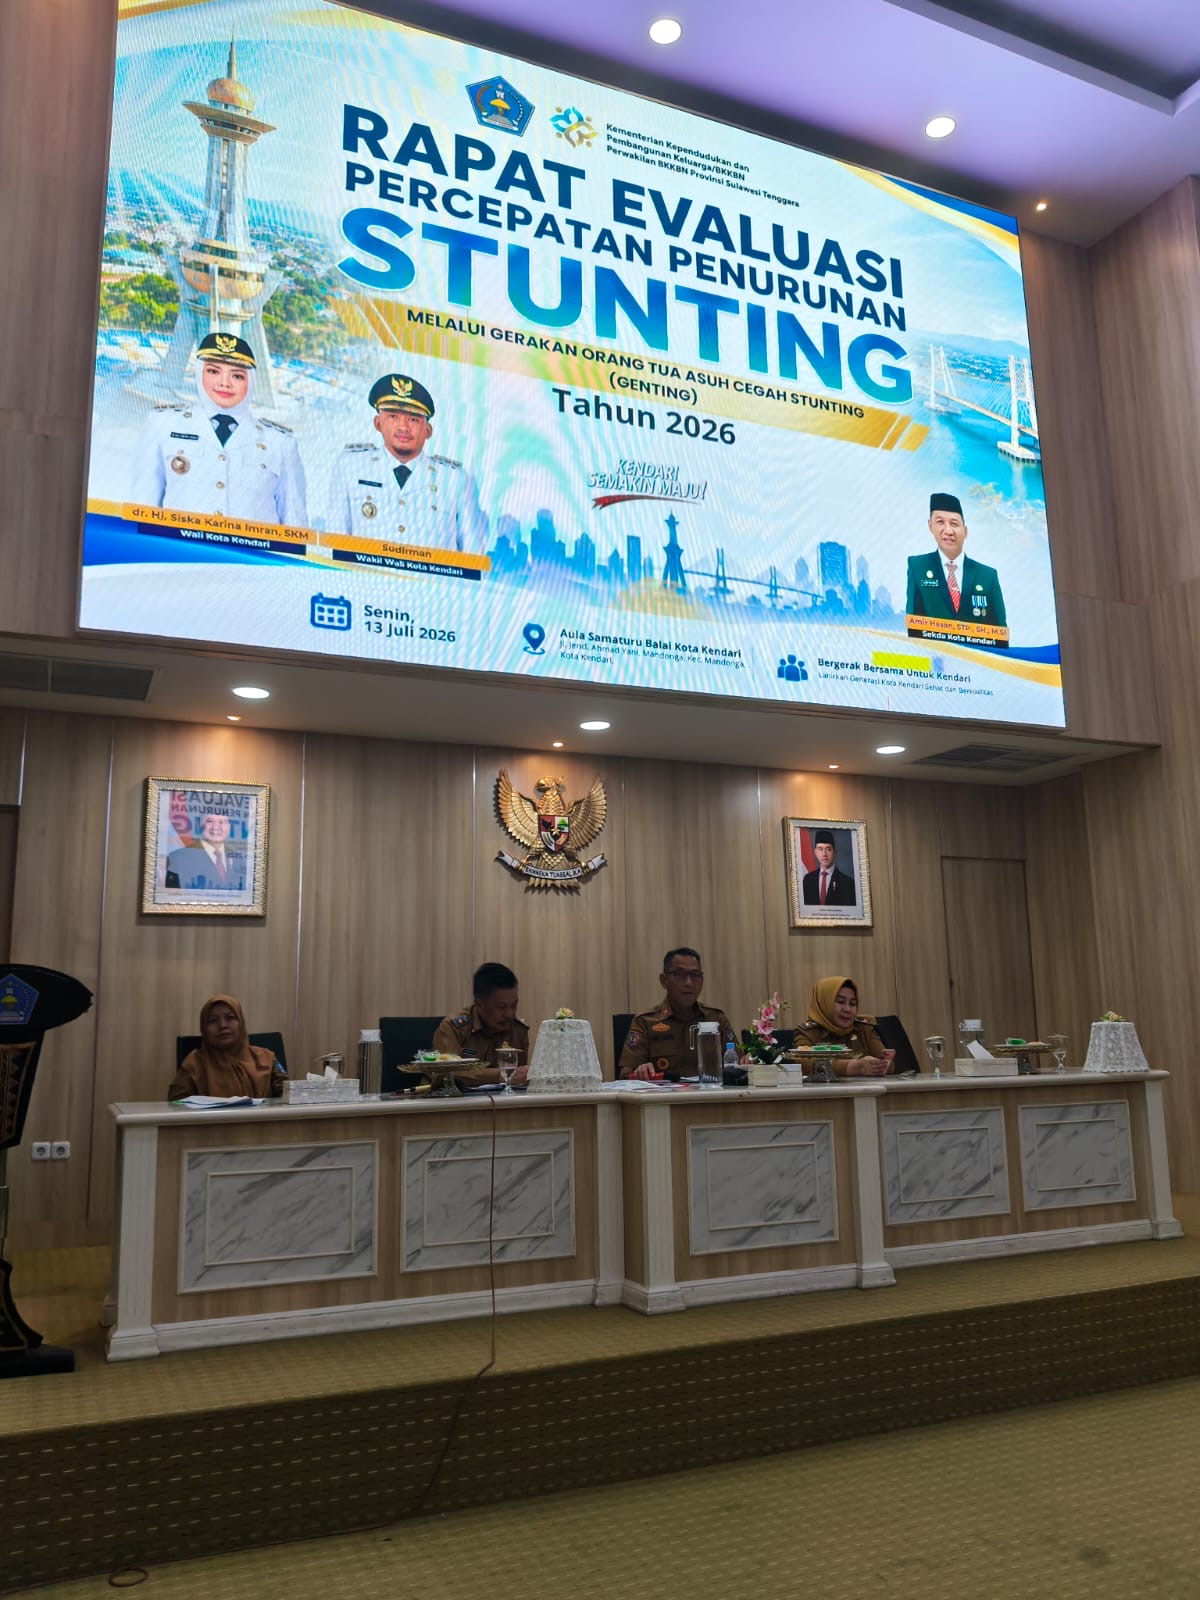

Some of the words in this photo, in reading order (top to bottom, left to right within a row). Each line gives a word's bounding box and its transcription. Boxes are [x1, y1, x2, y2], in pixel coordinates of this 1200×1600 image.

[606, 123, 664, 147] Kementerian
[666, 141, 731, 167] Kependudukan
[733, 162, 750, 173] dan
[606, 134, 672, 159] Pembangunan
[674, 153, 745, 181] Keluarga/BKKBN
[607, 145, 656, 166] Perwakilan
[658, 160, 688, 175] BKKBN
[690, 169, 724, 185] Provinsi
[725, 179, 761, 196] Sulawesi
[762, 190, 800, 208] Tenggara
[342, 103, 586, 210] RAPAT
[612, 178, 903, 299] EVALUASI
[345, 160, 652, 267] PERCEPATAN
[669, 244, 906, 332] PENURUNAN
[336, 207, 914, 405] STUNTING
[406, 309, 486, 337] MELALUI
[490, 327, 578, 357] GERAKAN
[581, 347, 645, 371] ORANG
[648, 362, 681, 380] TUA
[685, 370, 729, 390] ASUH
[733, 380, 787, 402] CEGAH
[790, 393, 865, 418] STUNTING
[609, 371, 698, 406] (GENTING)
[552, 387, 656, 430] Tahun
[666, 411, 736, 445] 2026
[616, 458, 680, 482] KENDARI
[587, 471, 656, 494] SEMAKIN
[658, 479, 708, 501] MAJU!
[131, 508, 149, 518] dr.
[170, 513, 201, 526] Siska
[204, 517, 242, 531] Karina
[284, 529, 309, 541] SKM
[180, 529, 204, 540] Wali
[206, 532, 230, 543] Kota
[231, 535, 271, 549] Kendari
[382, 543, 432, 559] Sudirman
[355, 554, 383, 565] Wakil
[384, 557, 405, 569] Wali
[406, 561, 428, 571] Kota
[429, 565, 464, 576] Kendari
[363, 604, 415, 625] Senin,
[909, 617, 928, 625] Amir
[364, 621, 383, 634] 13
[385, 623, 415, 638] Juli
[419, 627, 456, 643] 2026
[559, 628, 586, 640] Aula
[588, 632, 642, 647] Samaturu
[645, 638, 672, 651] Balai
[674, 642, 699, 653] Kota
[701, 645, 742, 659] Kendari
[922, 630, 946, 640] Sekda
[947, 633, 966, 642] Kota
[966, 636, 996, 646] Kendari
[560, 651, 579, 660] Kota
[591, 644, 620, 654] Ahmad
[817, 658, 861, 671] Bergerak
[863, 663, 904, 676] Bersama
[906, 668, 935, 679] Untuk
[936, 671, 971, 683] Kendari
[818, 672, 849, 681] Lahirkan
[849, 675, 880, 685] Generasi
[881, 679, 897, 687] Kota
[898, 680, 924, 689] Kendari
[924, 683, 943, 692] Sehat
